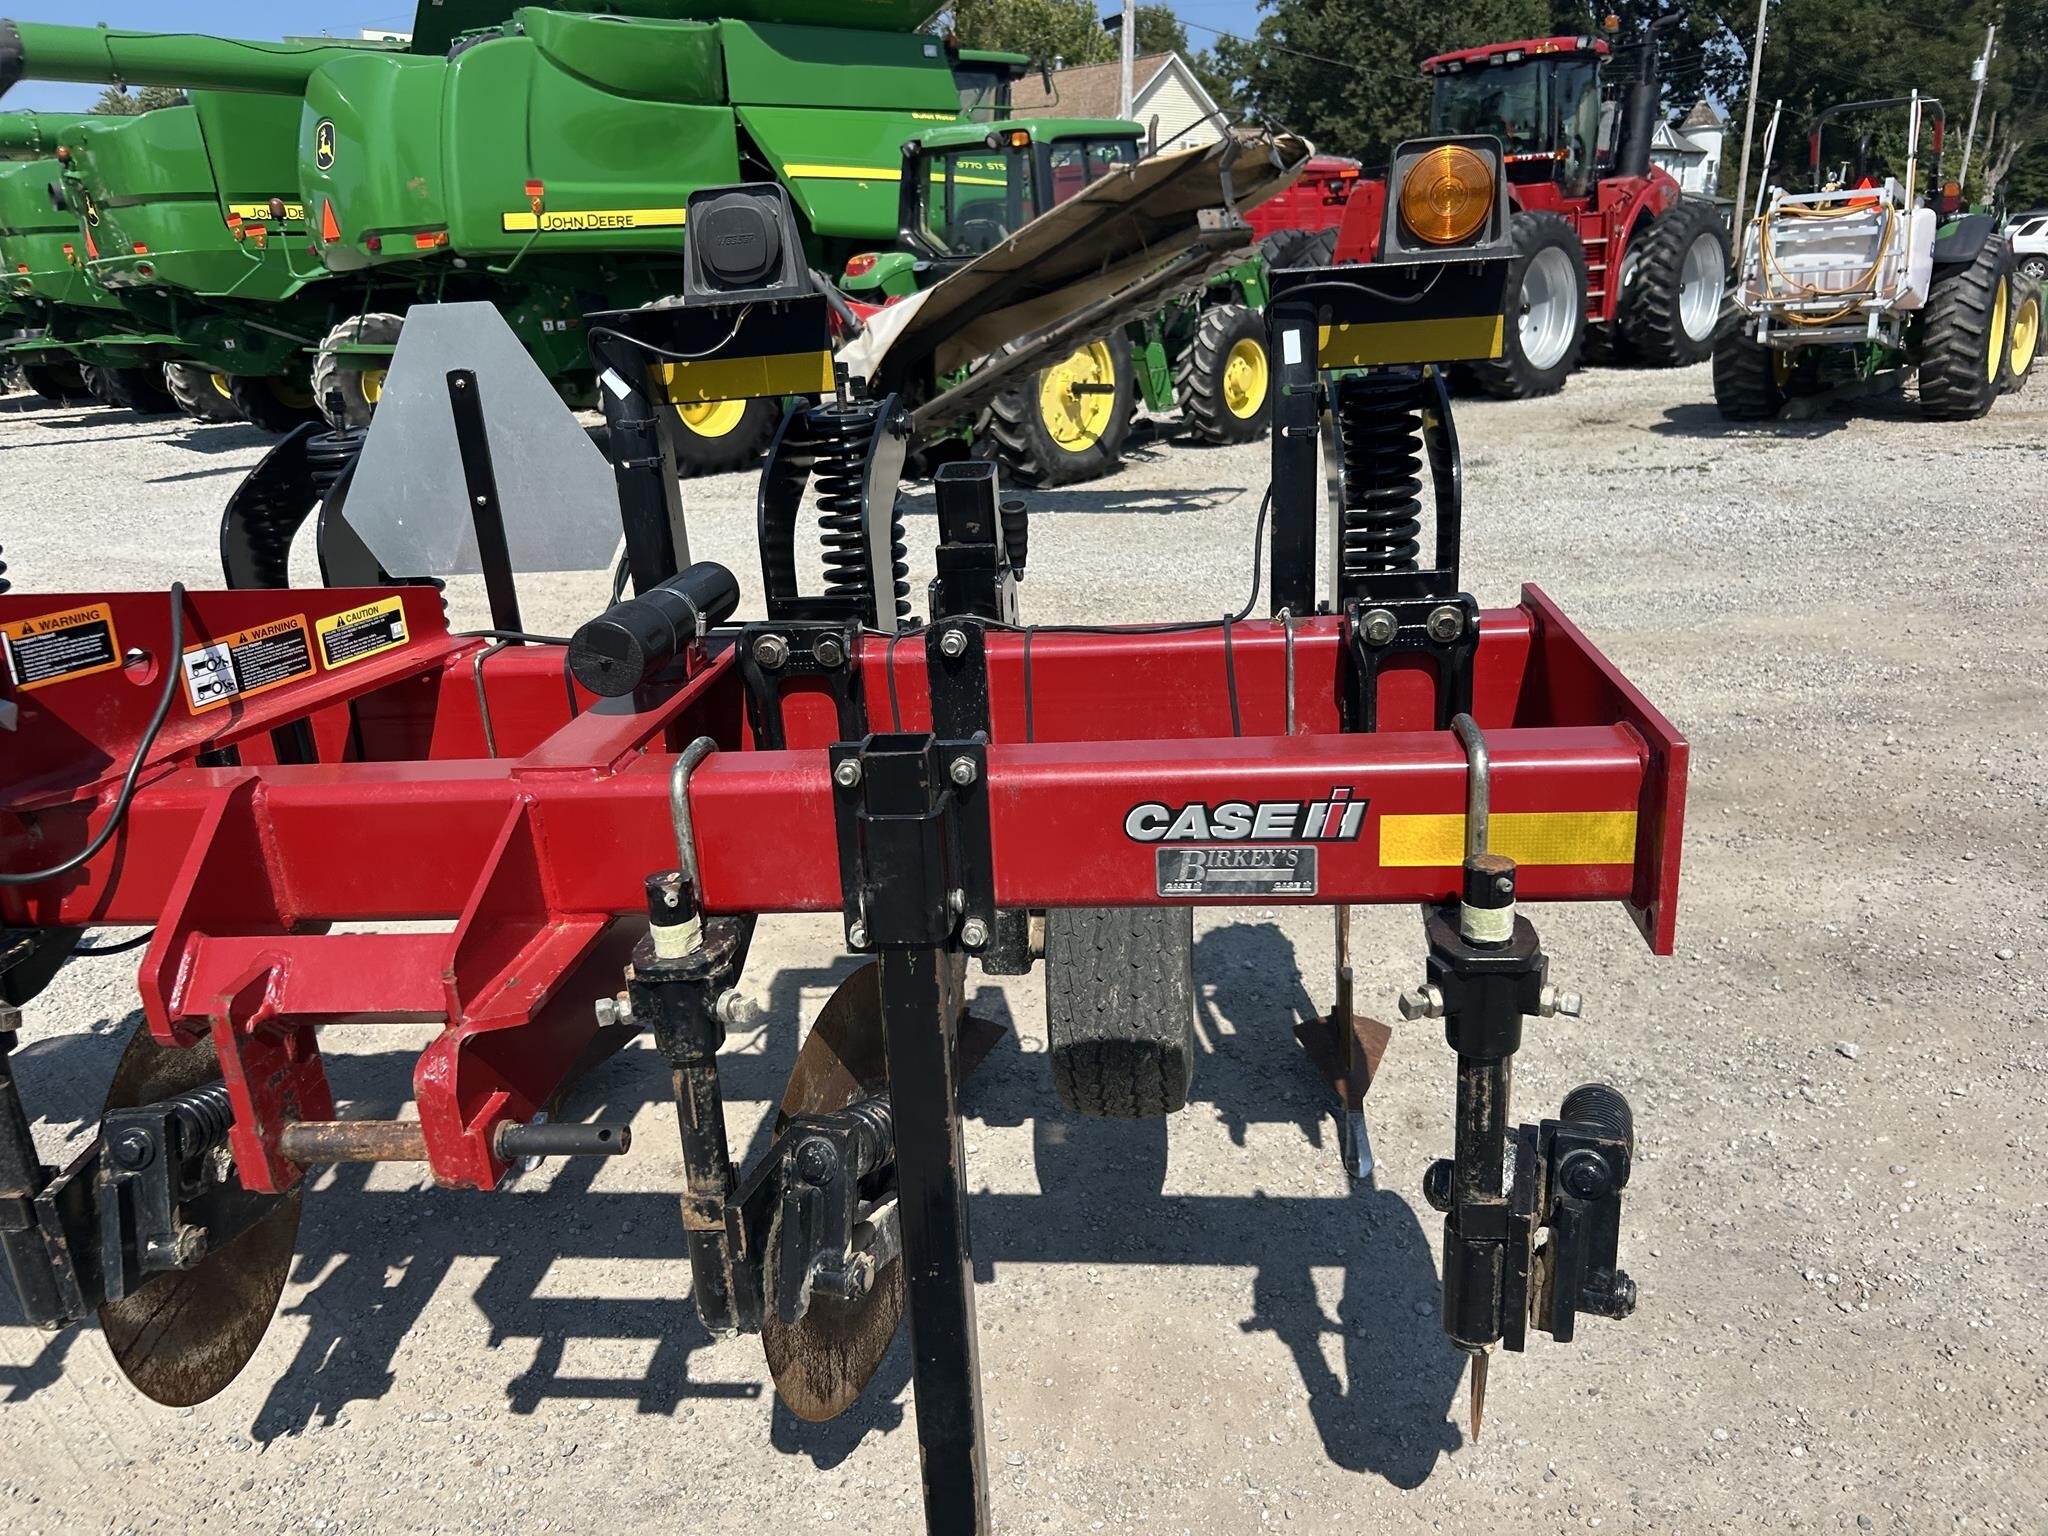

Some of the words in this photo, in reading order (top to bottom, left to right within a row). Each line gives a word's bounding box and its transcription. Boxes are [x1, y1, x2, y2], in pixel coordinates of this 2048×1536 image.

[956, 161, 983, 170] 9770
[986, 162, 1007, 171] STS
[543, 215, 584, 229] JOHN
[587, 214, 634, 227] DEERE
[38, 609, 100, 631] WARNING
[345, 605, 380, 623] CAUTION
[251, 619, 298, 640] WARNING
[1125, 803, 1300, 841] CASE
[1174, 849, 1299, 883] BIRKEY'S
